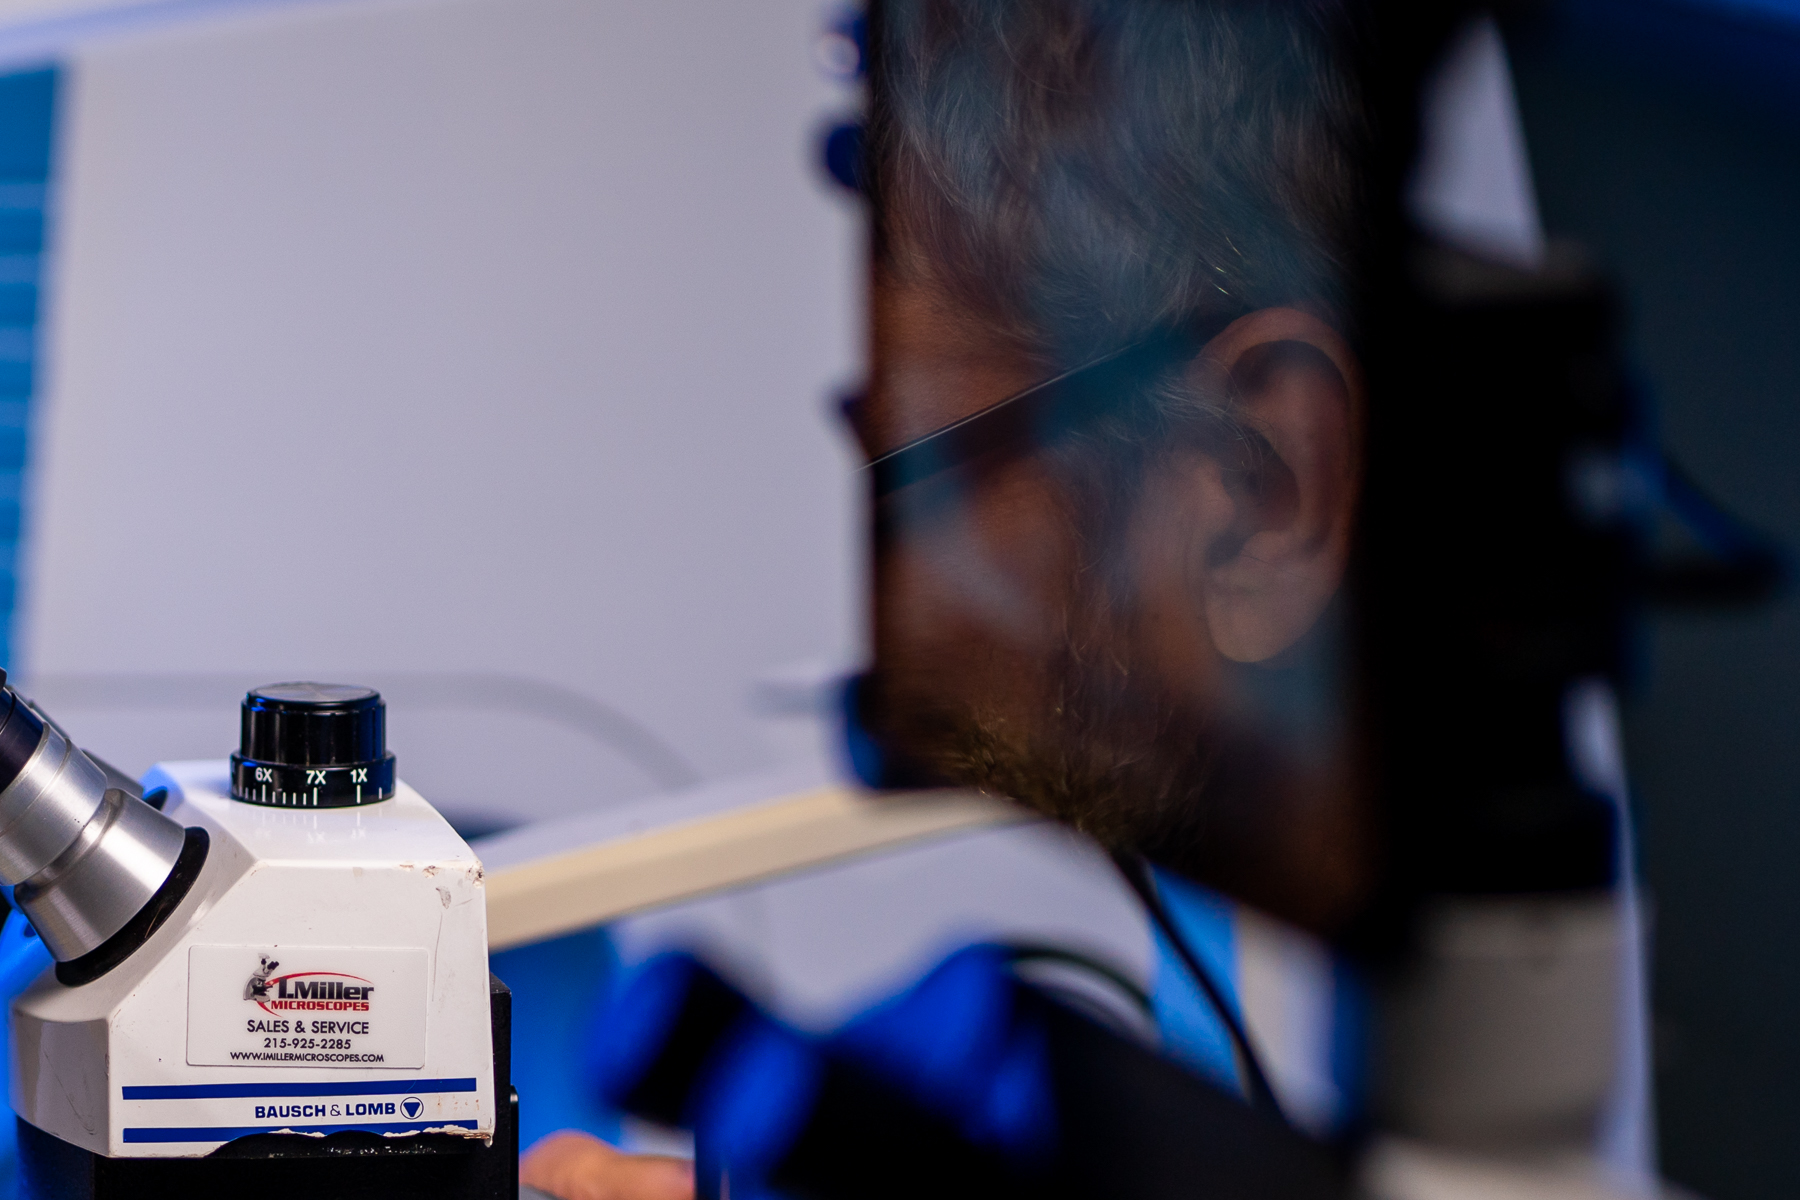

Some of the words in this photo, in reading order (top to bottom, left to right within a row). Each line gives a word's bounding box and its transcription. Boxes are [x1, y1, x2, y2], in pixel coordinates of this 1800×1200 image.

[254, 767, 273, 783] 6X
[305, 769, 327, 785] 7X
[350, 767, 368, 783] 1X
[270, 1000, 370, 1012] MICROSCOPES
[246, 1019, 290, 1034] SALES
[294, 1020, 306, 1034] &
[311, 1020, 370, 1035] SERVICE
[263, 1037, 352, 1050] 215-925-2285
[229, 1051, 385, 1063] WWW.IMILLERMICROSCOPES.COM
[254, 1103, 327, 1119] BAUSCH
[330, 1103, 343, 1117] &
[345, 1102, 397, 1117] LOMB
